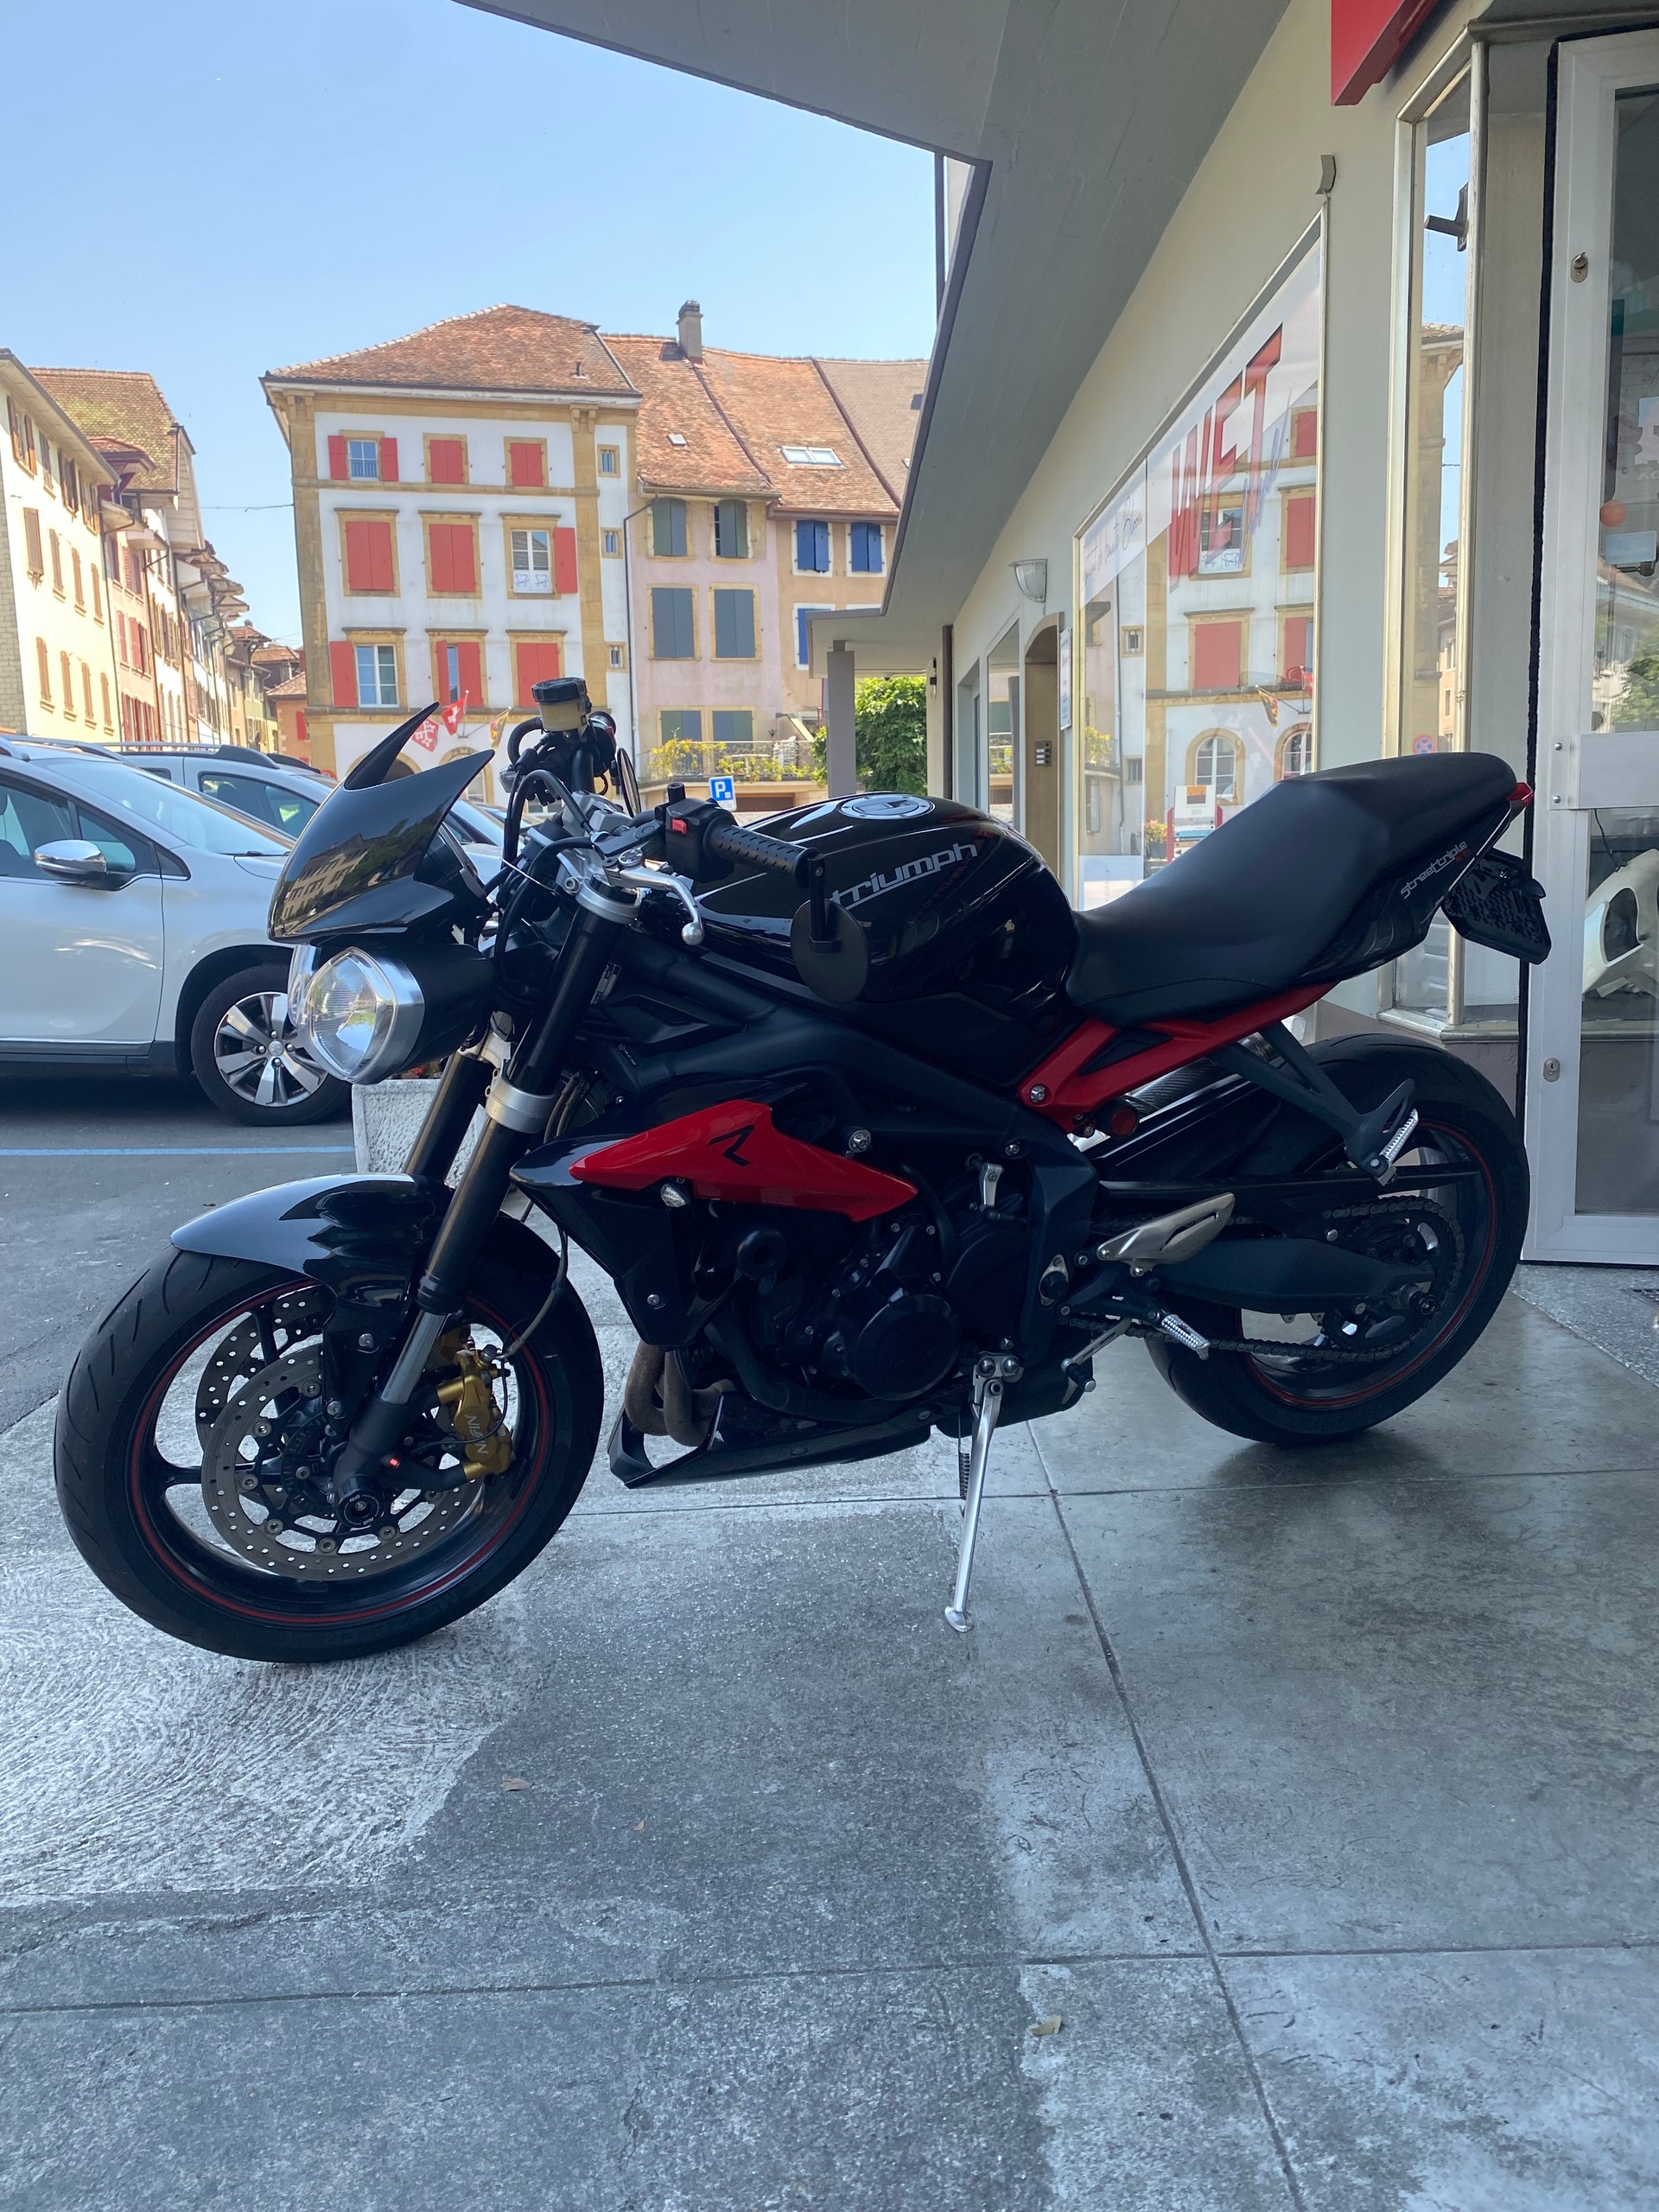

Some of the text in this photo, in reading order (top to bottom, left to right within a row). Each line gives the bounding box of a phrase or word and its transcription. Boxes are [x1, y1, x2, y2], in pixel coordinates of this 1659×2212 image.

[1169, 322, 1283, 593] WET
[715, 781, 726, 798] P
[830, 842, 978, 911] triumph
[464, 1414, 490, 1455] NISSIN
